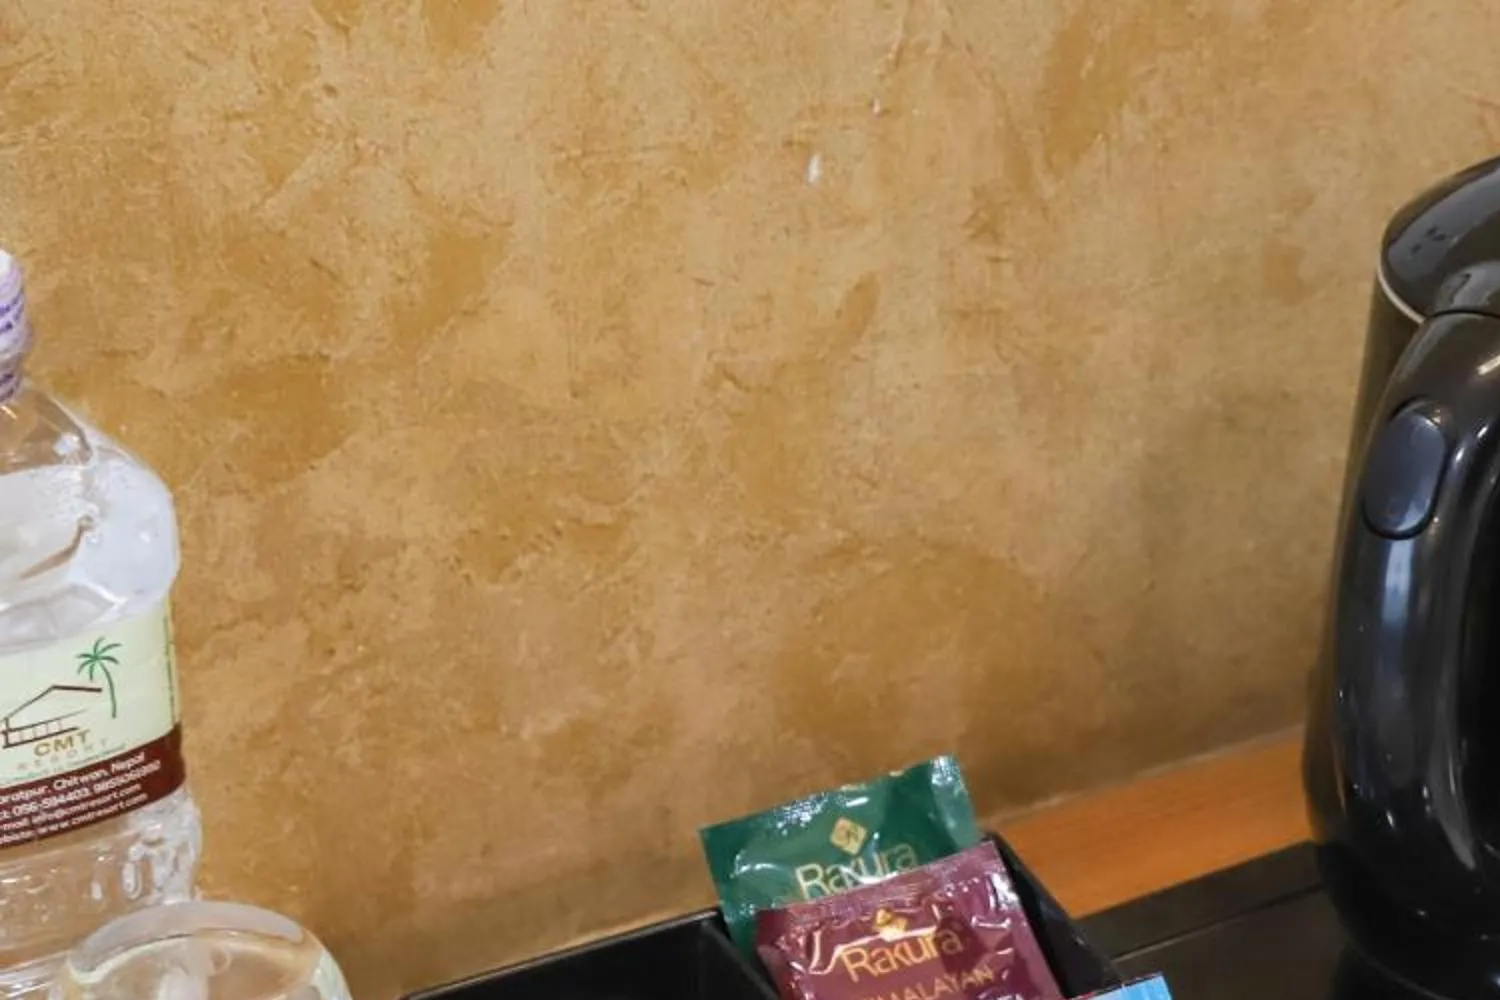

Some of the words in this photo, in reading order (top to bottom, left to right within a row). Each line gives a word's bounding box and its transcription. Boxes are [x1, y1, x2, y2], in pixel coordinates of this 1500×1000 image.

[33, 729, 90, 757] CMT
[111, 751, 145, 774] Nepal
[840, 928, 963, 983] Rakura
